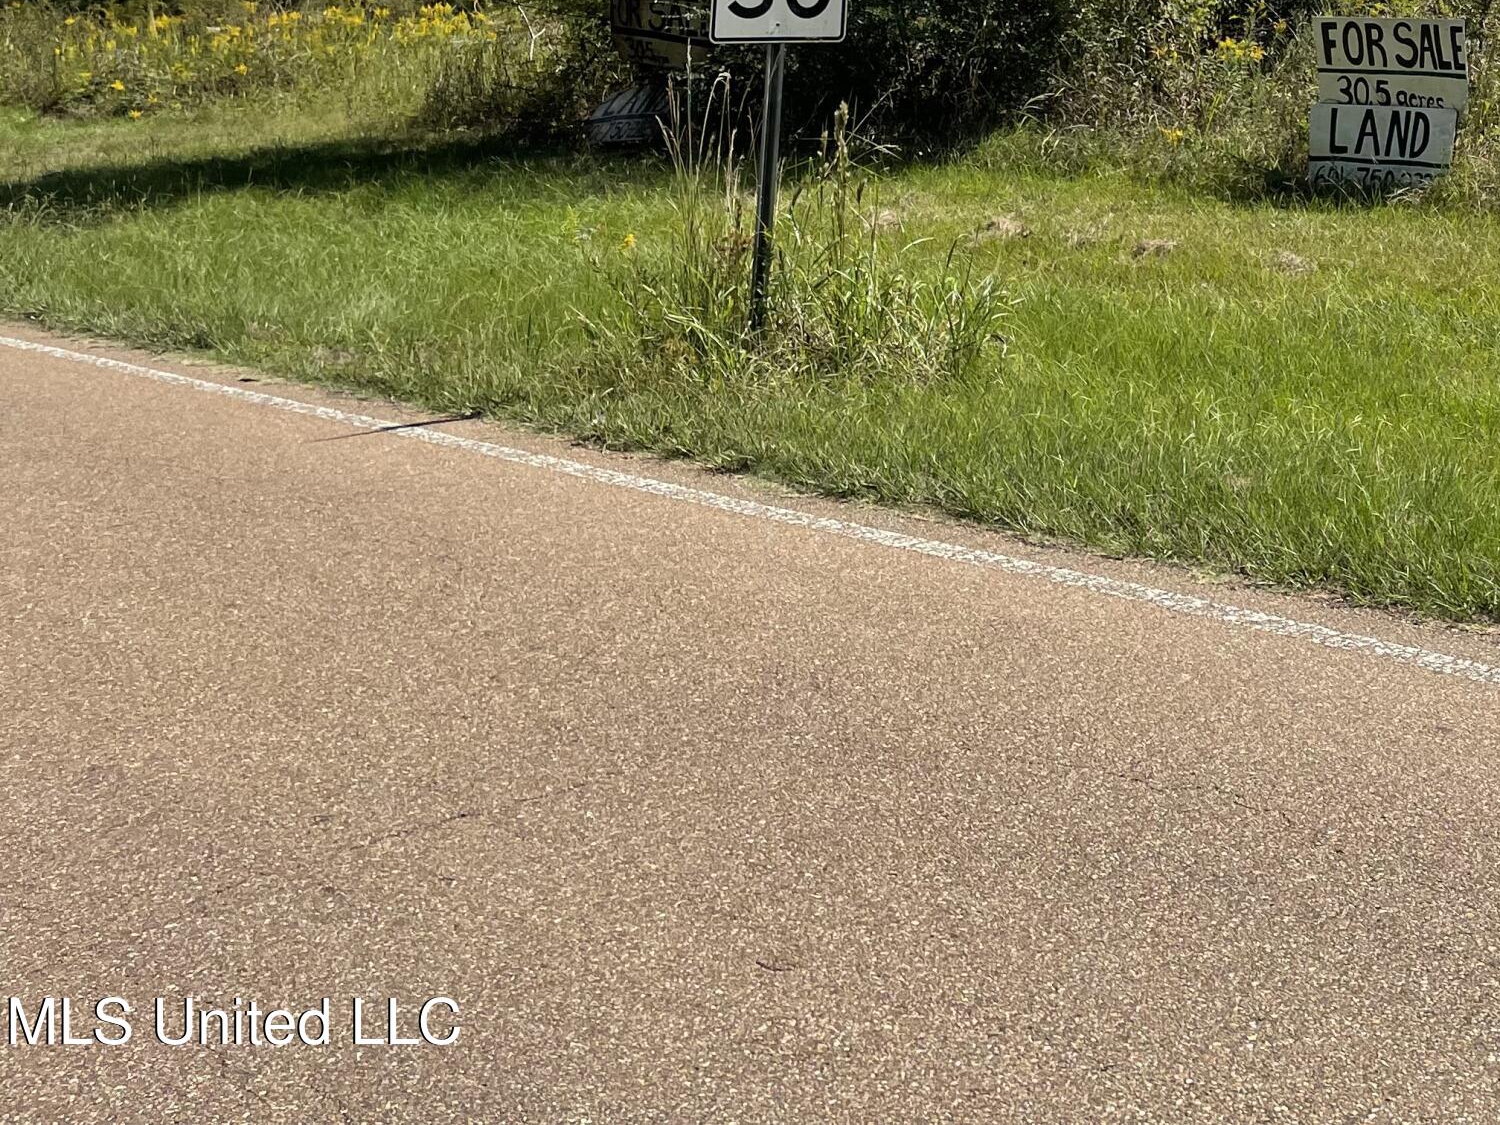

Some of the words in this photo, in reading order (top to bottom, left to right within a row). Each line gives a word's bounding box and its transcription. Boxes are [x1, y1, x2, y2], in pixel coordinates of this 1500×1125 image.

[1321, 20, 1387, 68] FOR
[1393, 21, 1466, 71] SALE
[1336, 75, 1391, 106] 30.5
[1396, 89, 1444, 109] acres
[1329, 107, 1430, 159] LAND
